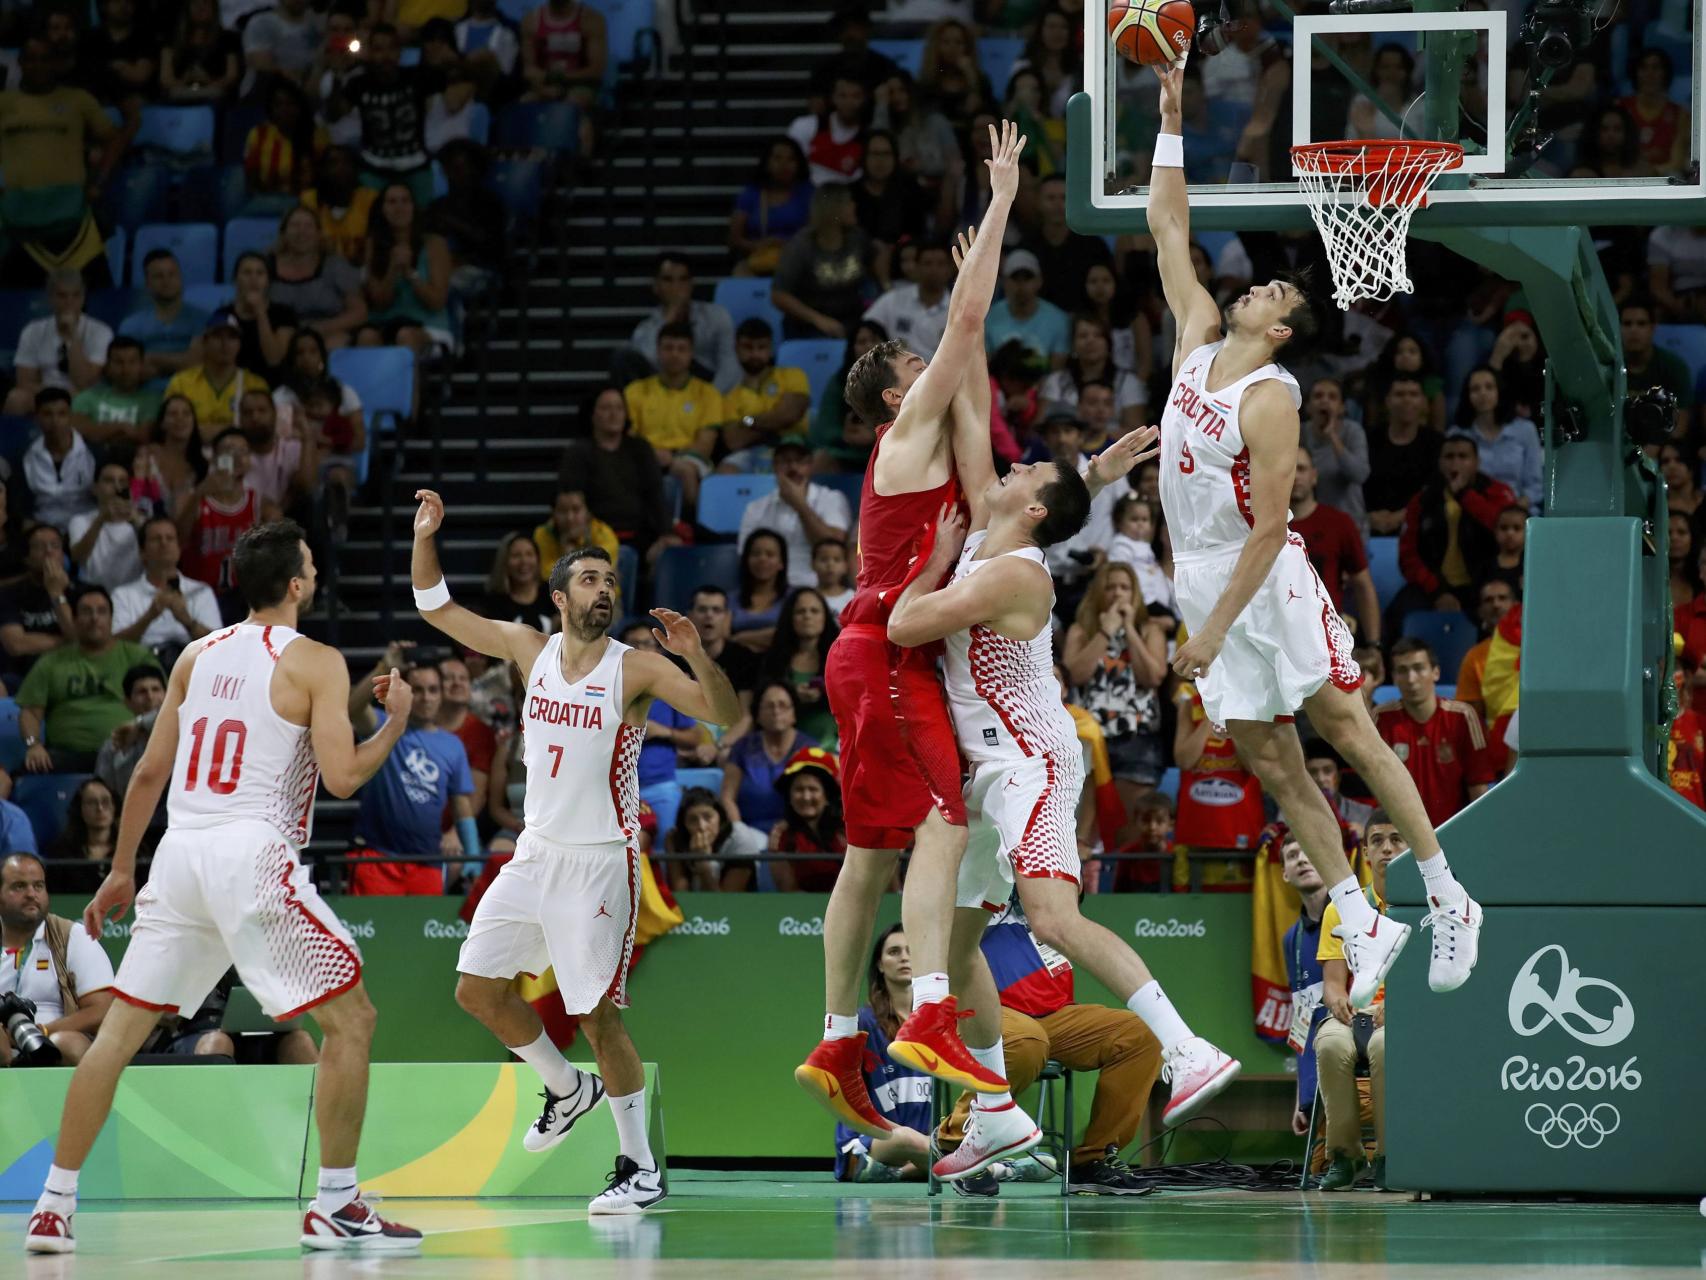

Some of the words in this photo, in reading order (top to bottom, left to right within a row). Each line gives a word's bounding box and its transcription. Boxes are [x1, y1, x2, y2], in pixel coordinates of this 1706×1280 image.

[1179, 440, 1195, 475] 9
[529, 695, 603, 730] CROATIA
[184, 716, 248, 795] 10
[547, 744, 564, 779] 7
[424, 919, 470, 938] Rio2
[779, 917, 824, 936] Rio2
[1134, 918, 1206, 938] Rio2016
[1501, 1055, 1643, 1091] Rio2016
